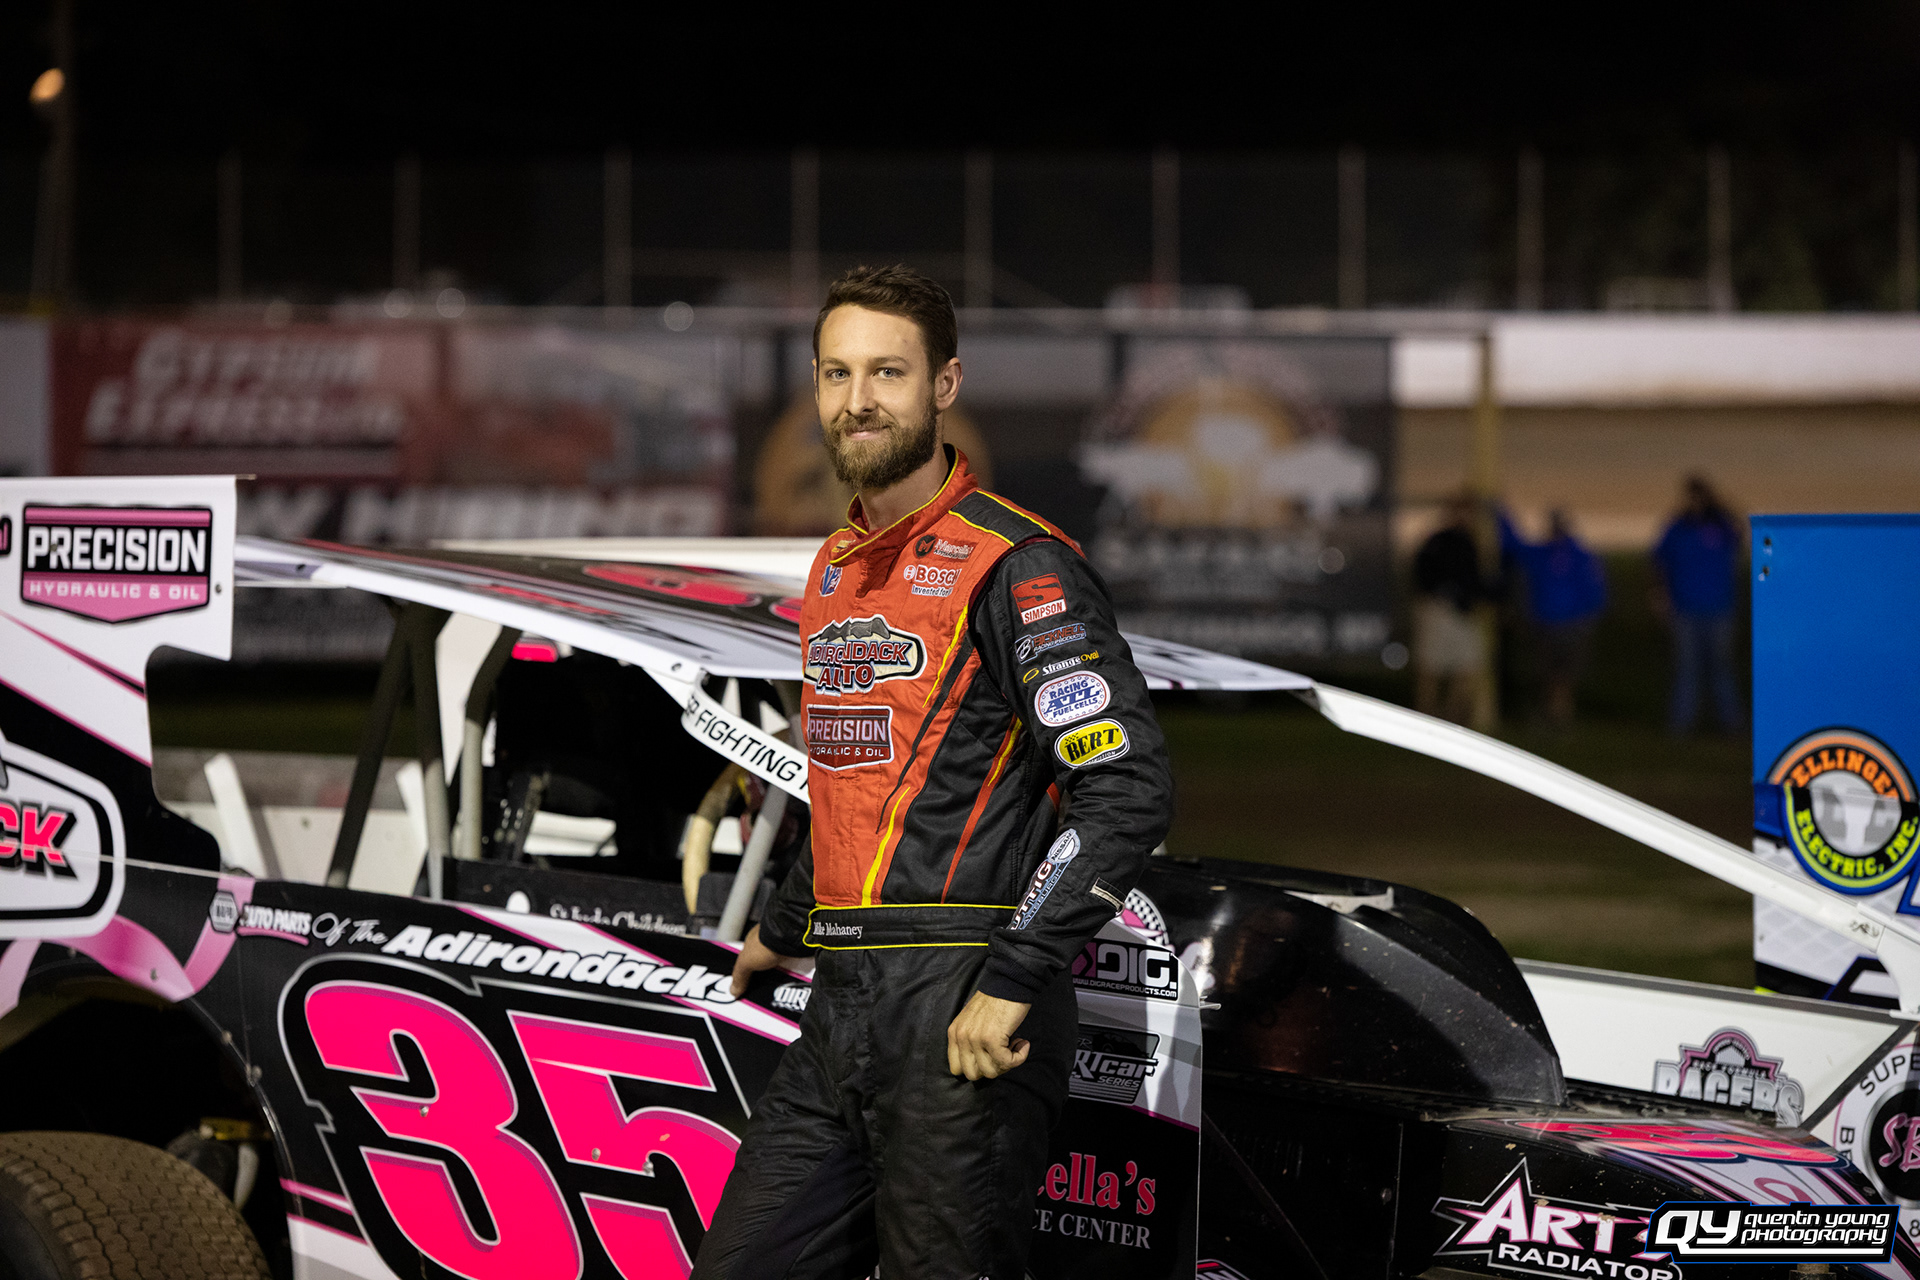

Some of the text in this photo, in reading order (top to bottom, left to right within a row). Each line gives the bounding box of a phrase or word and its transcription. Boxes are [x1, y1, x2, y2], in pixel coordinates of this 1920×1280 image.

[27, 526, 206, 573] PRECISION
[915, 565, 962, 585] BOSCH
[30, 583, 200, 600] HYDRAULIC & OIL
[1023, 601, 1063, 623] SIMPSON
[1032, 625, 1085, 647] BICKNELL
[817, 664, 875, 690] AUTO
[1043, 685, 1100, 715] ATL
[1049, 680, 1089, 699] RACING
[1052, 697, 1098, 718] FUEL CELLS
[809, 719, 887, 742] PRECISION
[695, 709, 803, 782] FIGHTING
[855, 747, 861, 757] &
[865, 747, 884, 757] OIL
[1065, 728, 1119, 763] BERT
[825, 922, 864, 939] Mahaney
[273, 908, 313, 936] PARTS
[312, 912, 351, 947] Of
[348, 919, 390, 946] The
[380, 924, 738, 1003] Adirondacks
[1097, 1075, 1141, 1088] SERIES
[304, 980, 742, 1280] 35
[1037, 1151, 1156, 1215] ella's
[1058, 1213, 1151, 1249] CENTER
[1498, 1243, 1674, 1280] RADIATOR
